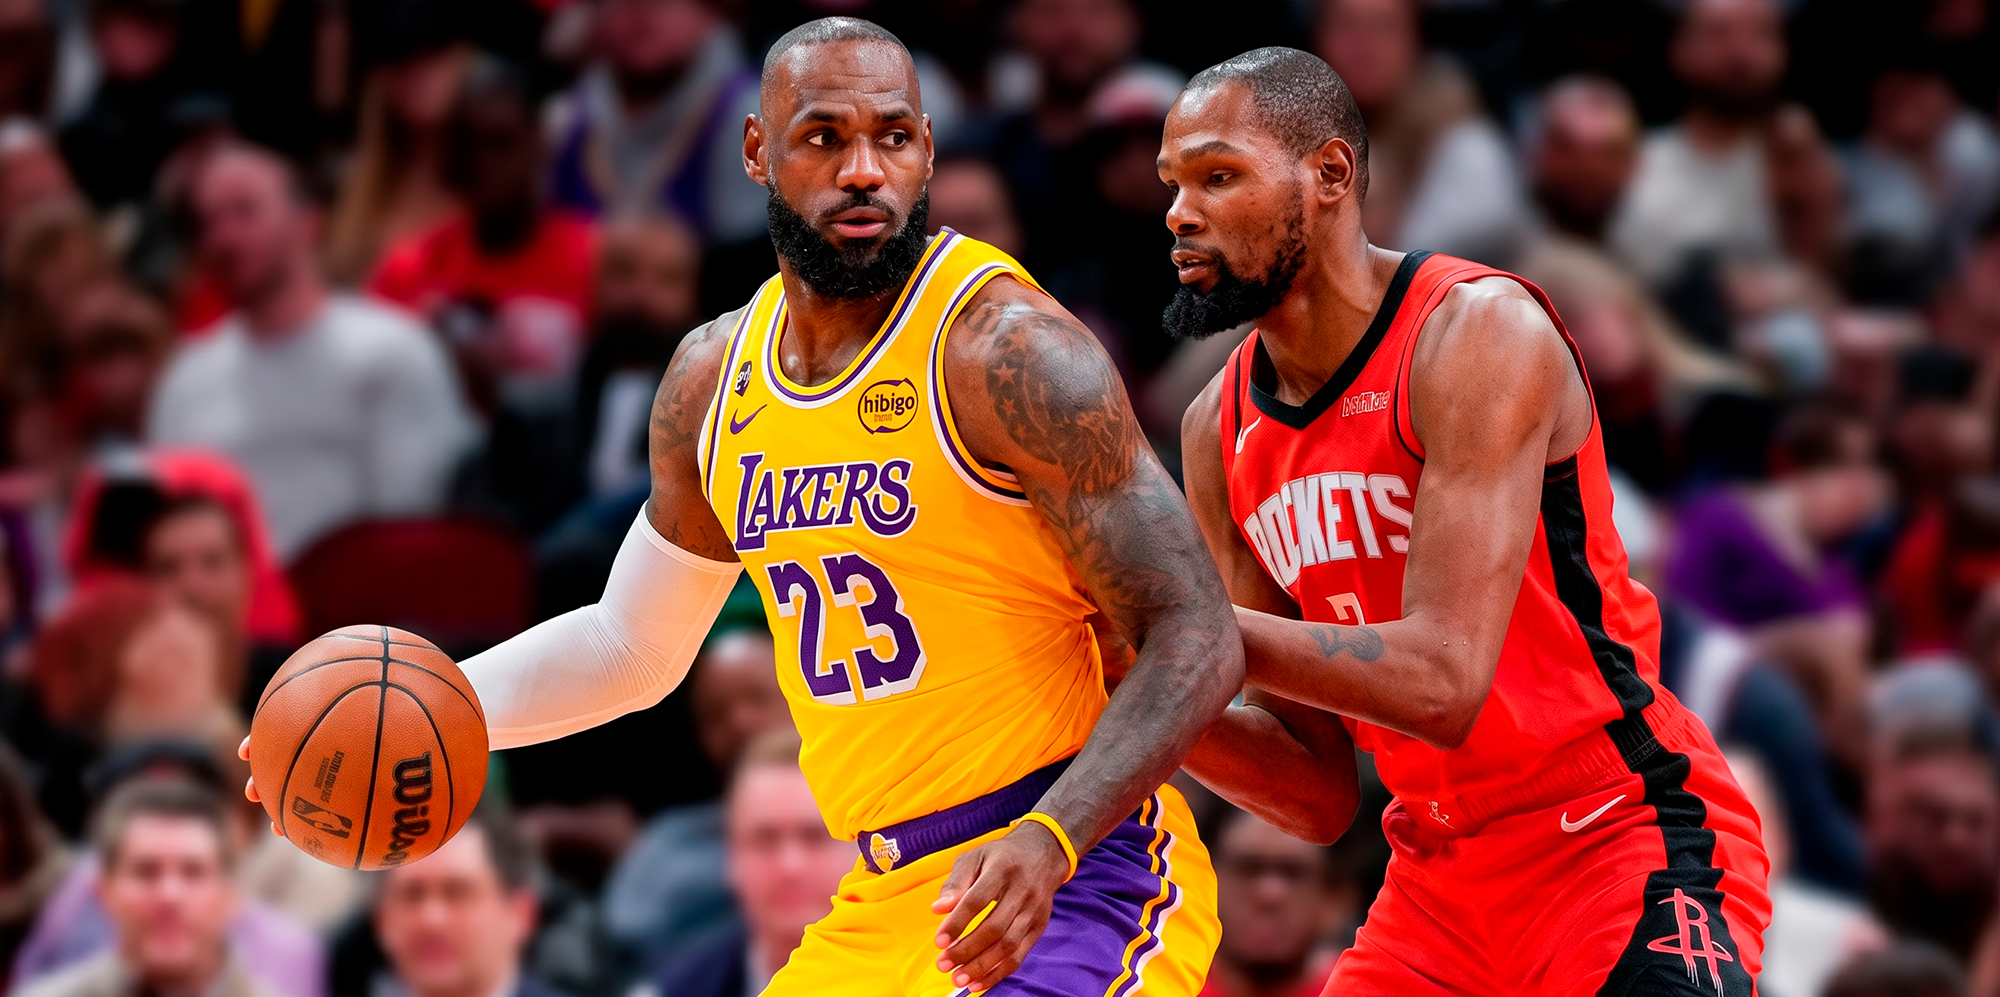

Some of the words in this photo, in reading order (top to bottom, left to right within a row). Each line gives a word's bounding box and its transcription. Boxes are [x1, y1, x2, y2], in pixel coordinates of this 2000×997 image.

[864, 392, 915, 416] hibigo
[734, 451, 919, 552] LAKERS
[764, 551, 928, 705] 23
